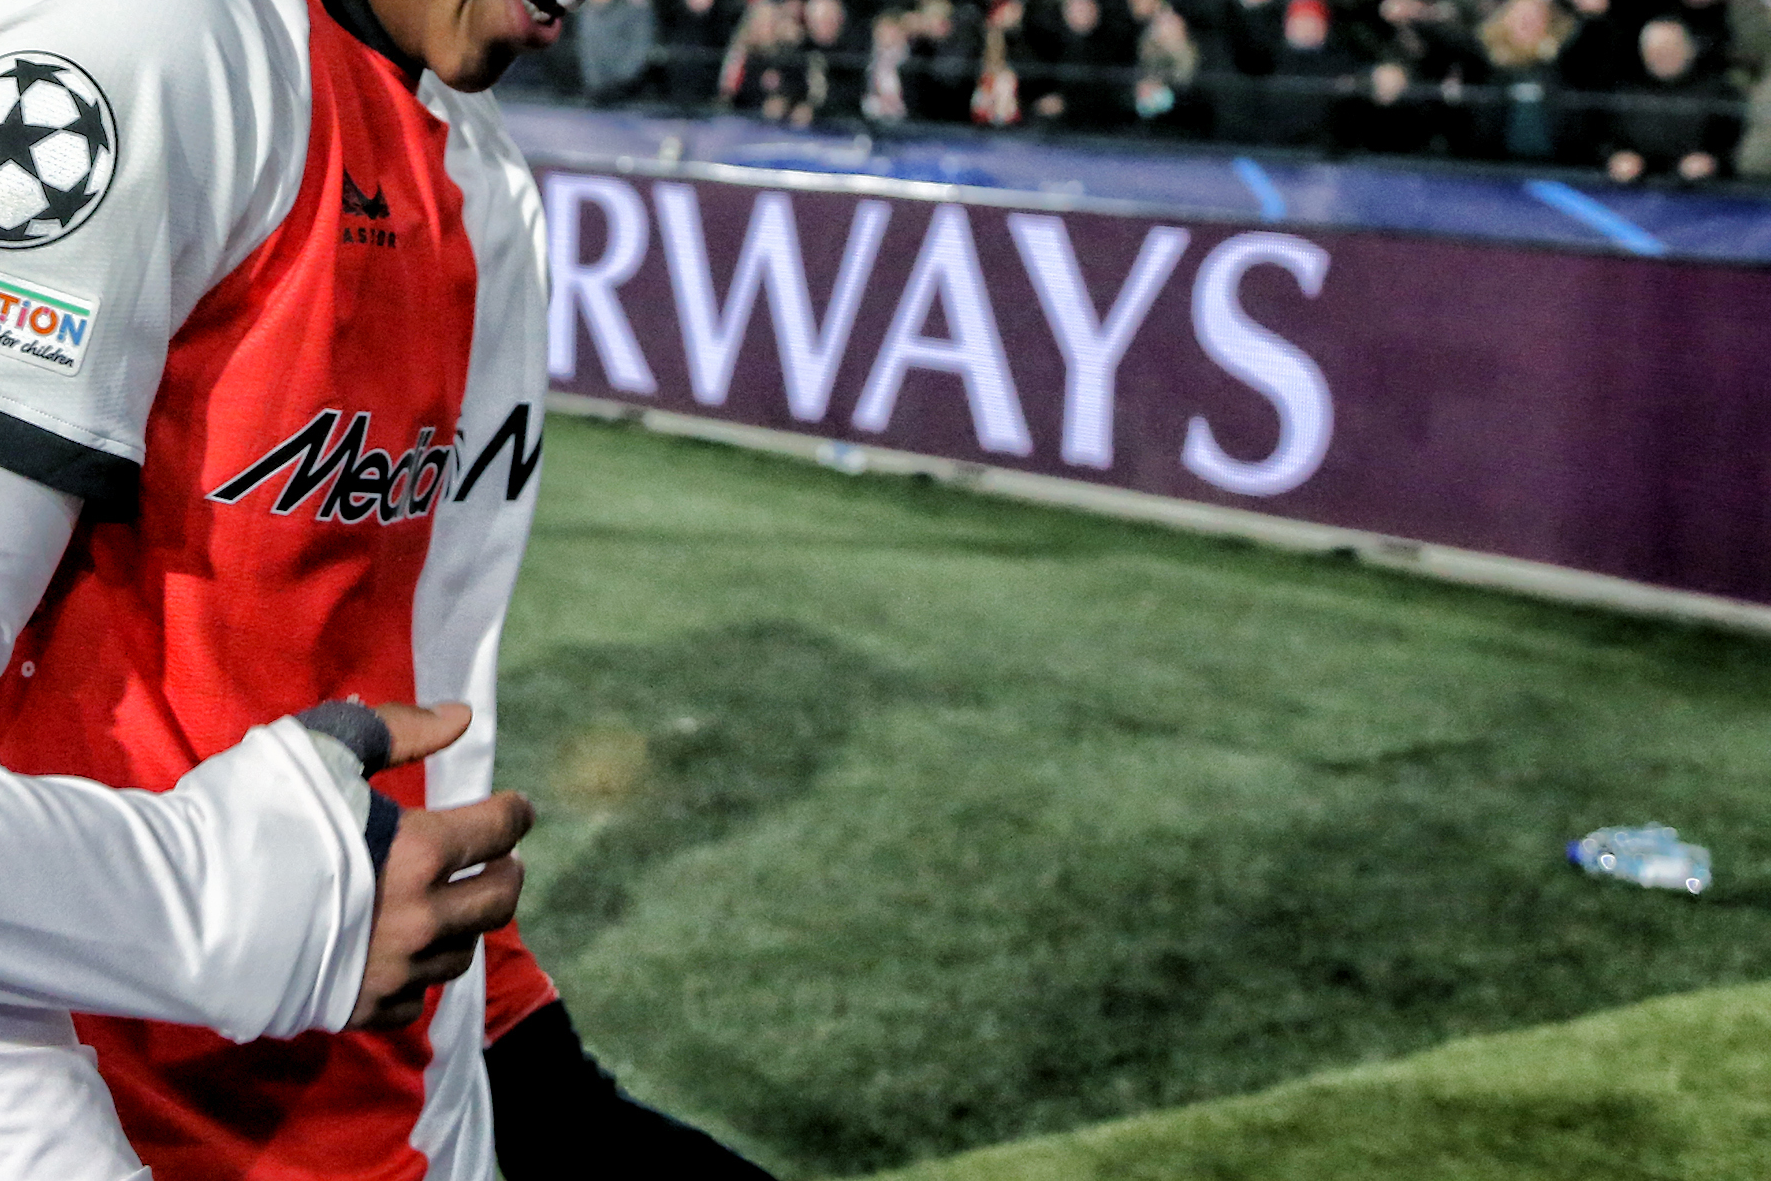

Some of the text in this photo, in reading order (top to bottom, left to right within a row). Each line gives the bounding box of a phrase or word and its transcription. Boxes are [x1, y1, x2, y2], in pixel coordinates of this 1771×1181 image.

[341, 226, 397, 249] ASTOR
[545, 171, 1335, 498] RWAYS
[20, 340, 75, 368] children
